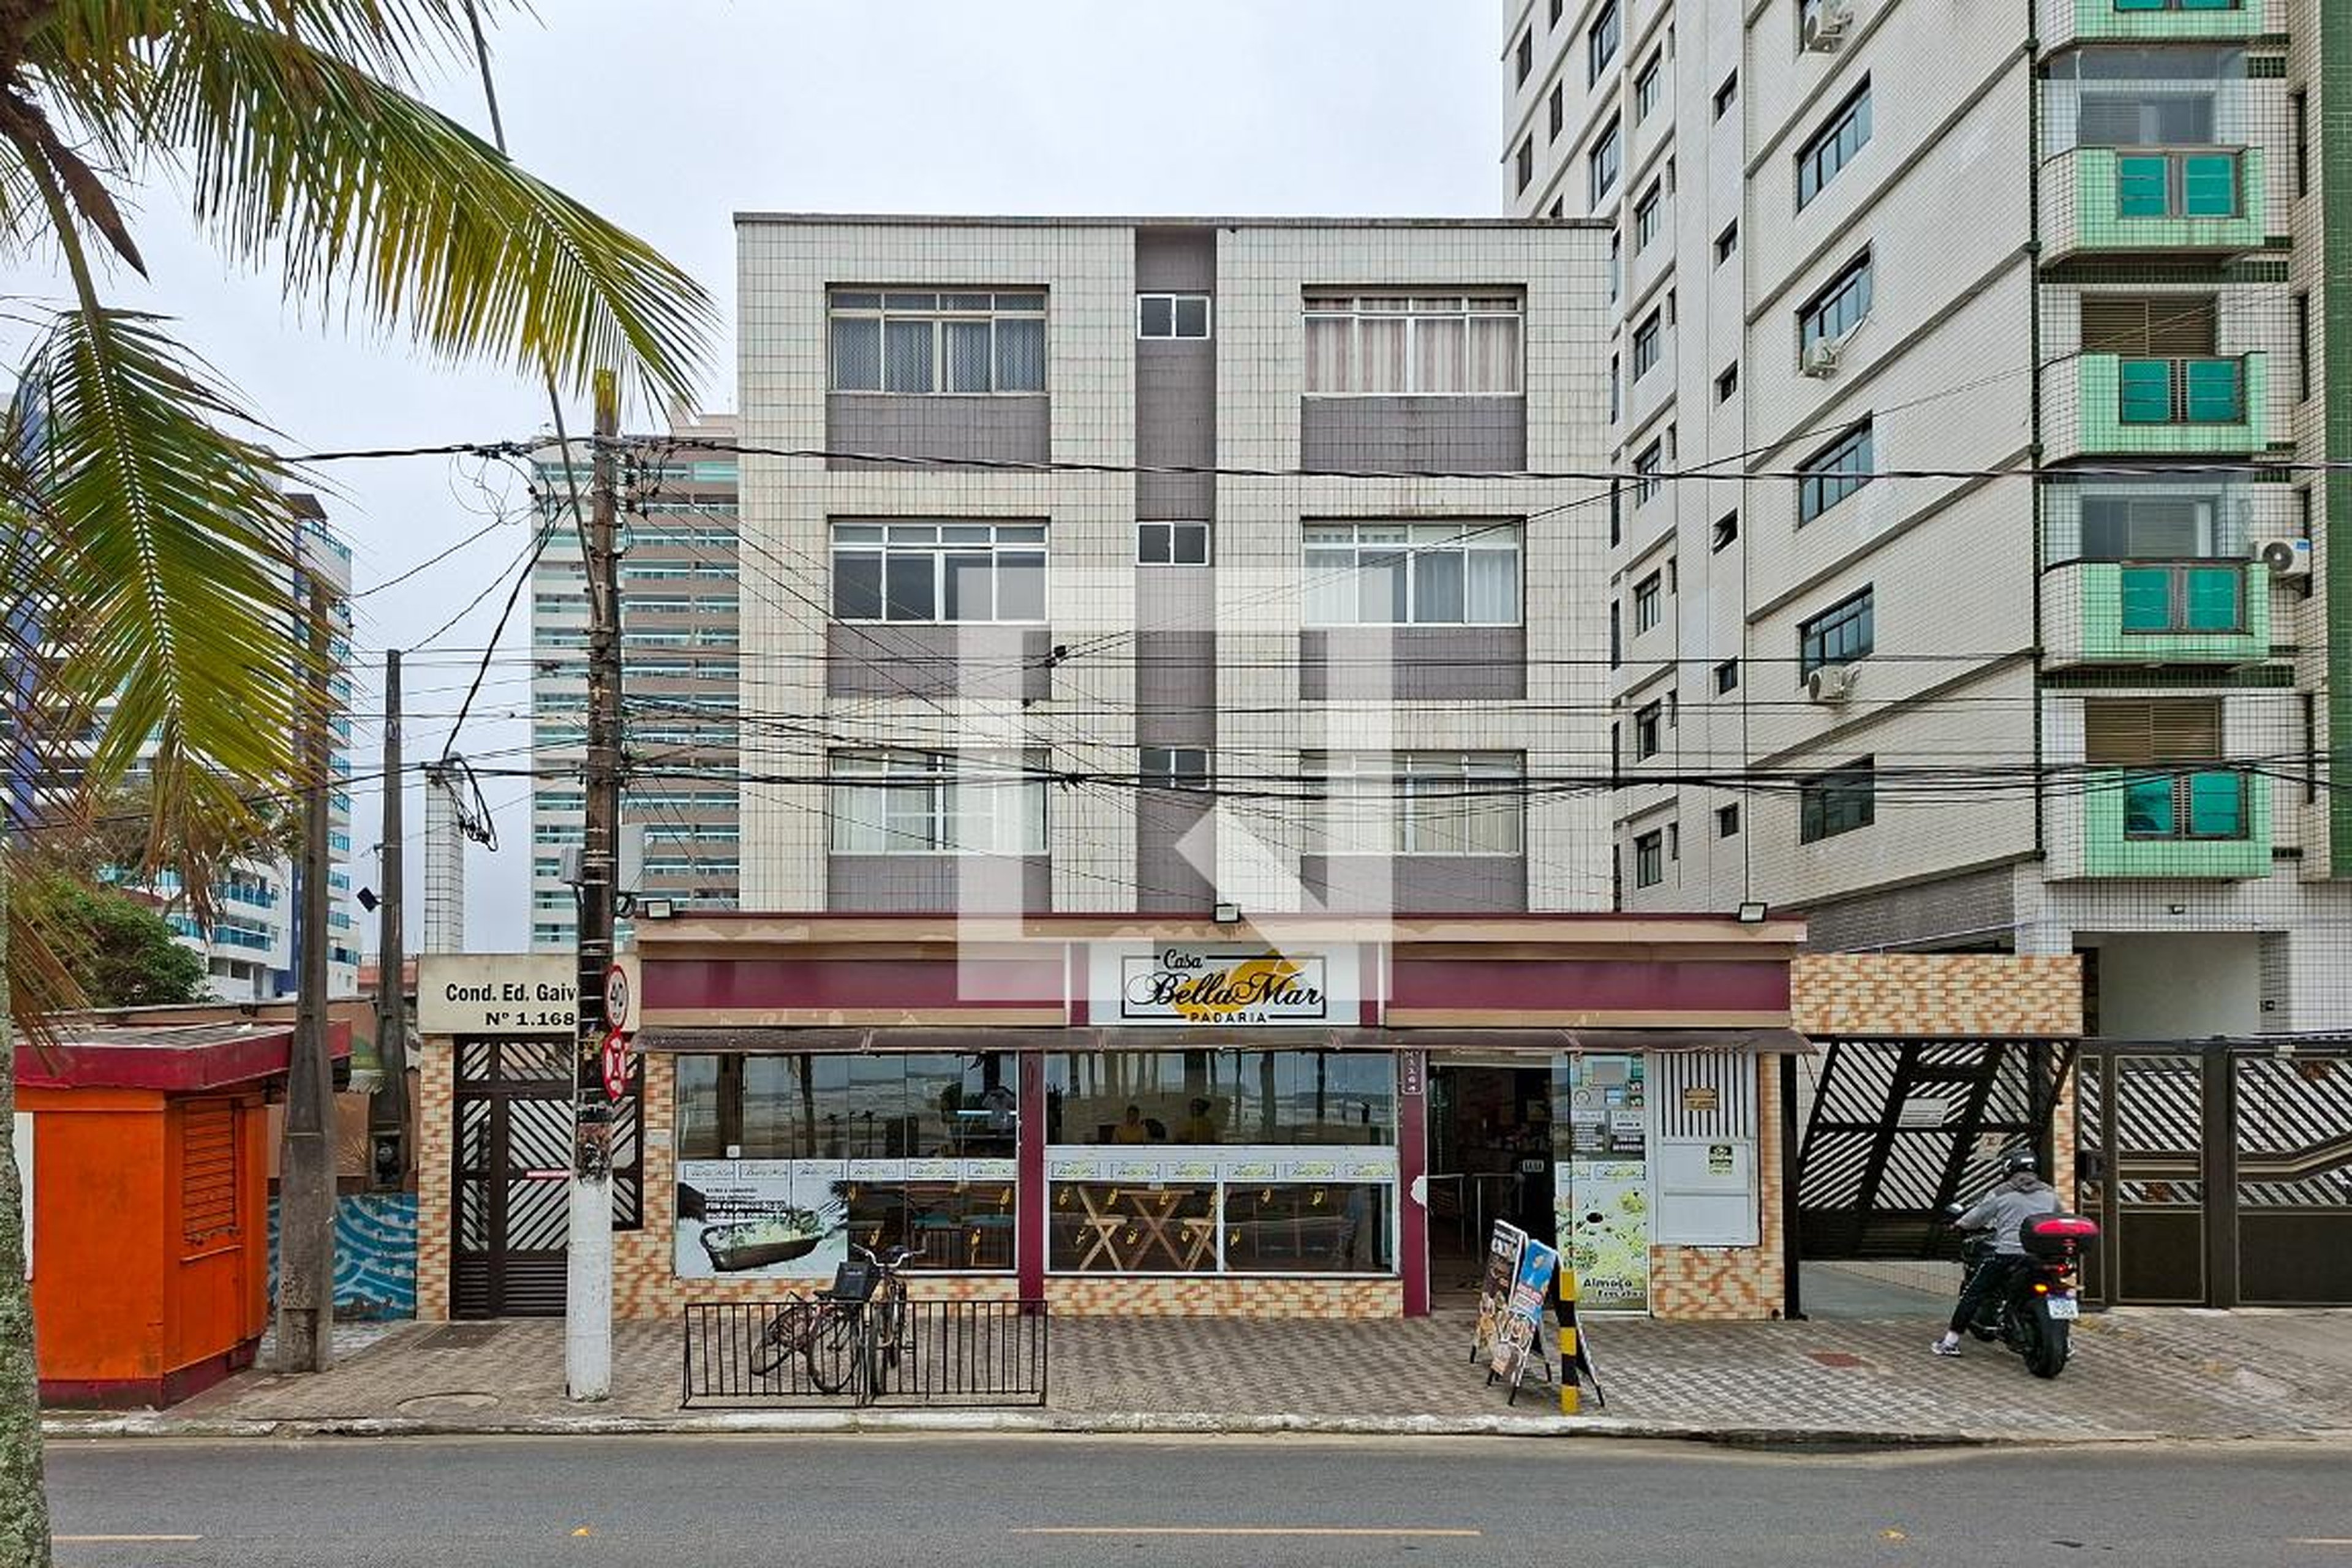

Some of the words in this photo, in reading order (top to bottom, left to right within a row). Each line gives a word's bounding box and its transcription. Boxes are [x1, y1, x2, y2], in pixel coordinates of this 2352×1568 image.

[1164, 949, 1203, 969] Casa
[446, 983, 497, 1001] Cond.
[503, 983, 530, 1001] Ed.
[536, 982, 576, 1001] Gaiv
[516, 1012, 575, 1026] 1.168
[1190, 1012, 1267, 1023] PADARIA
